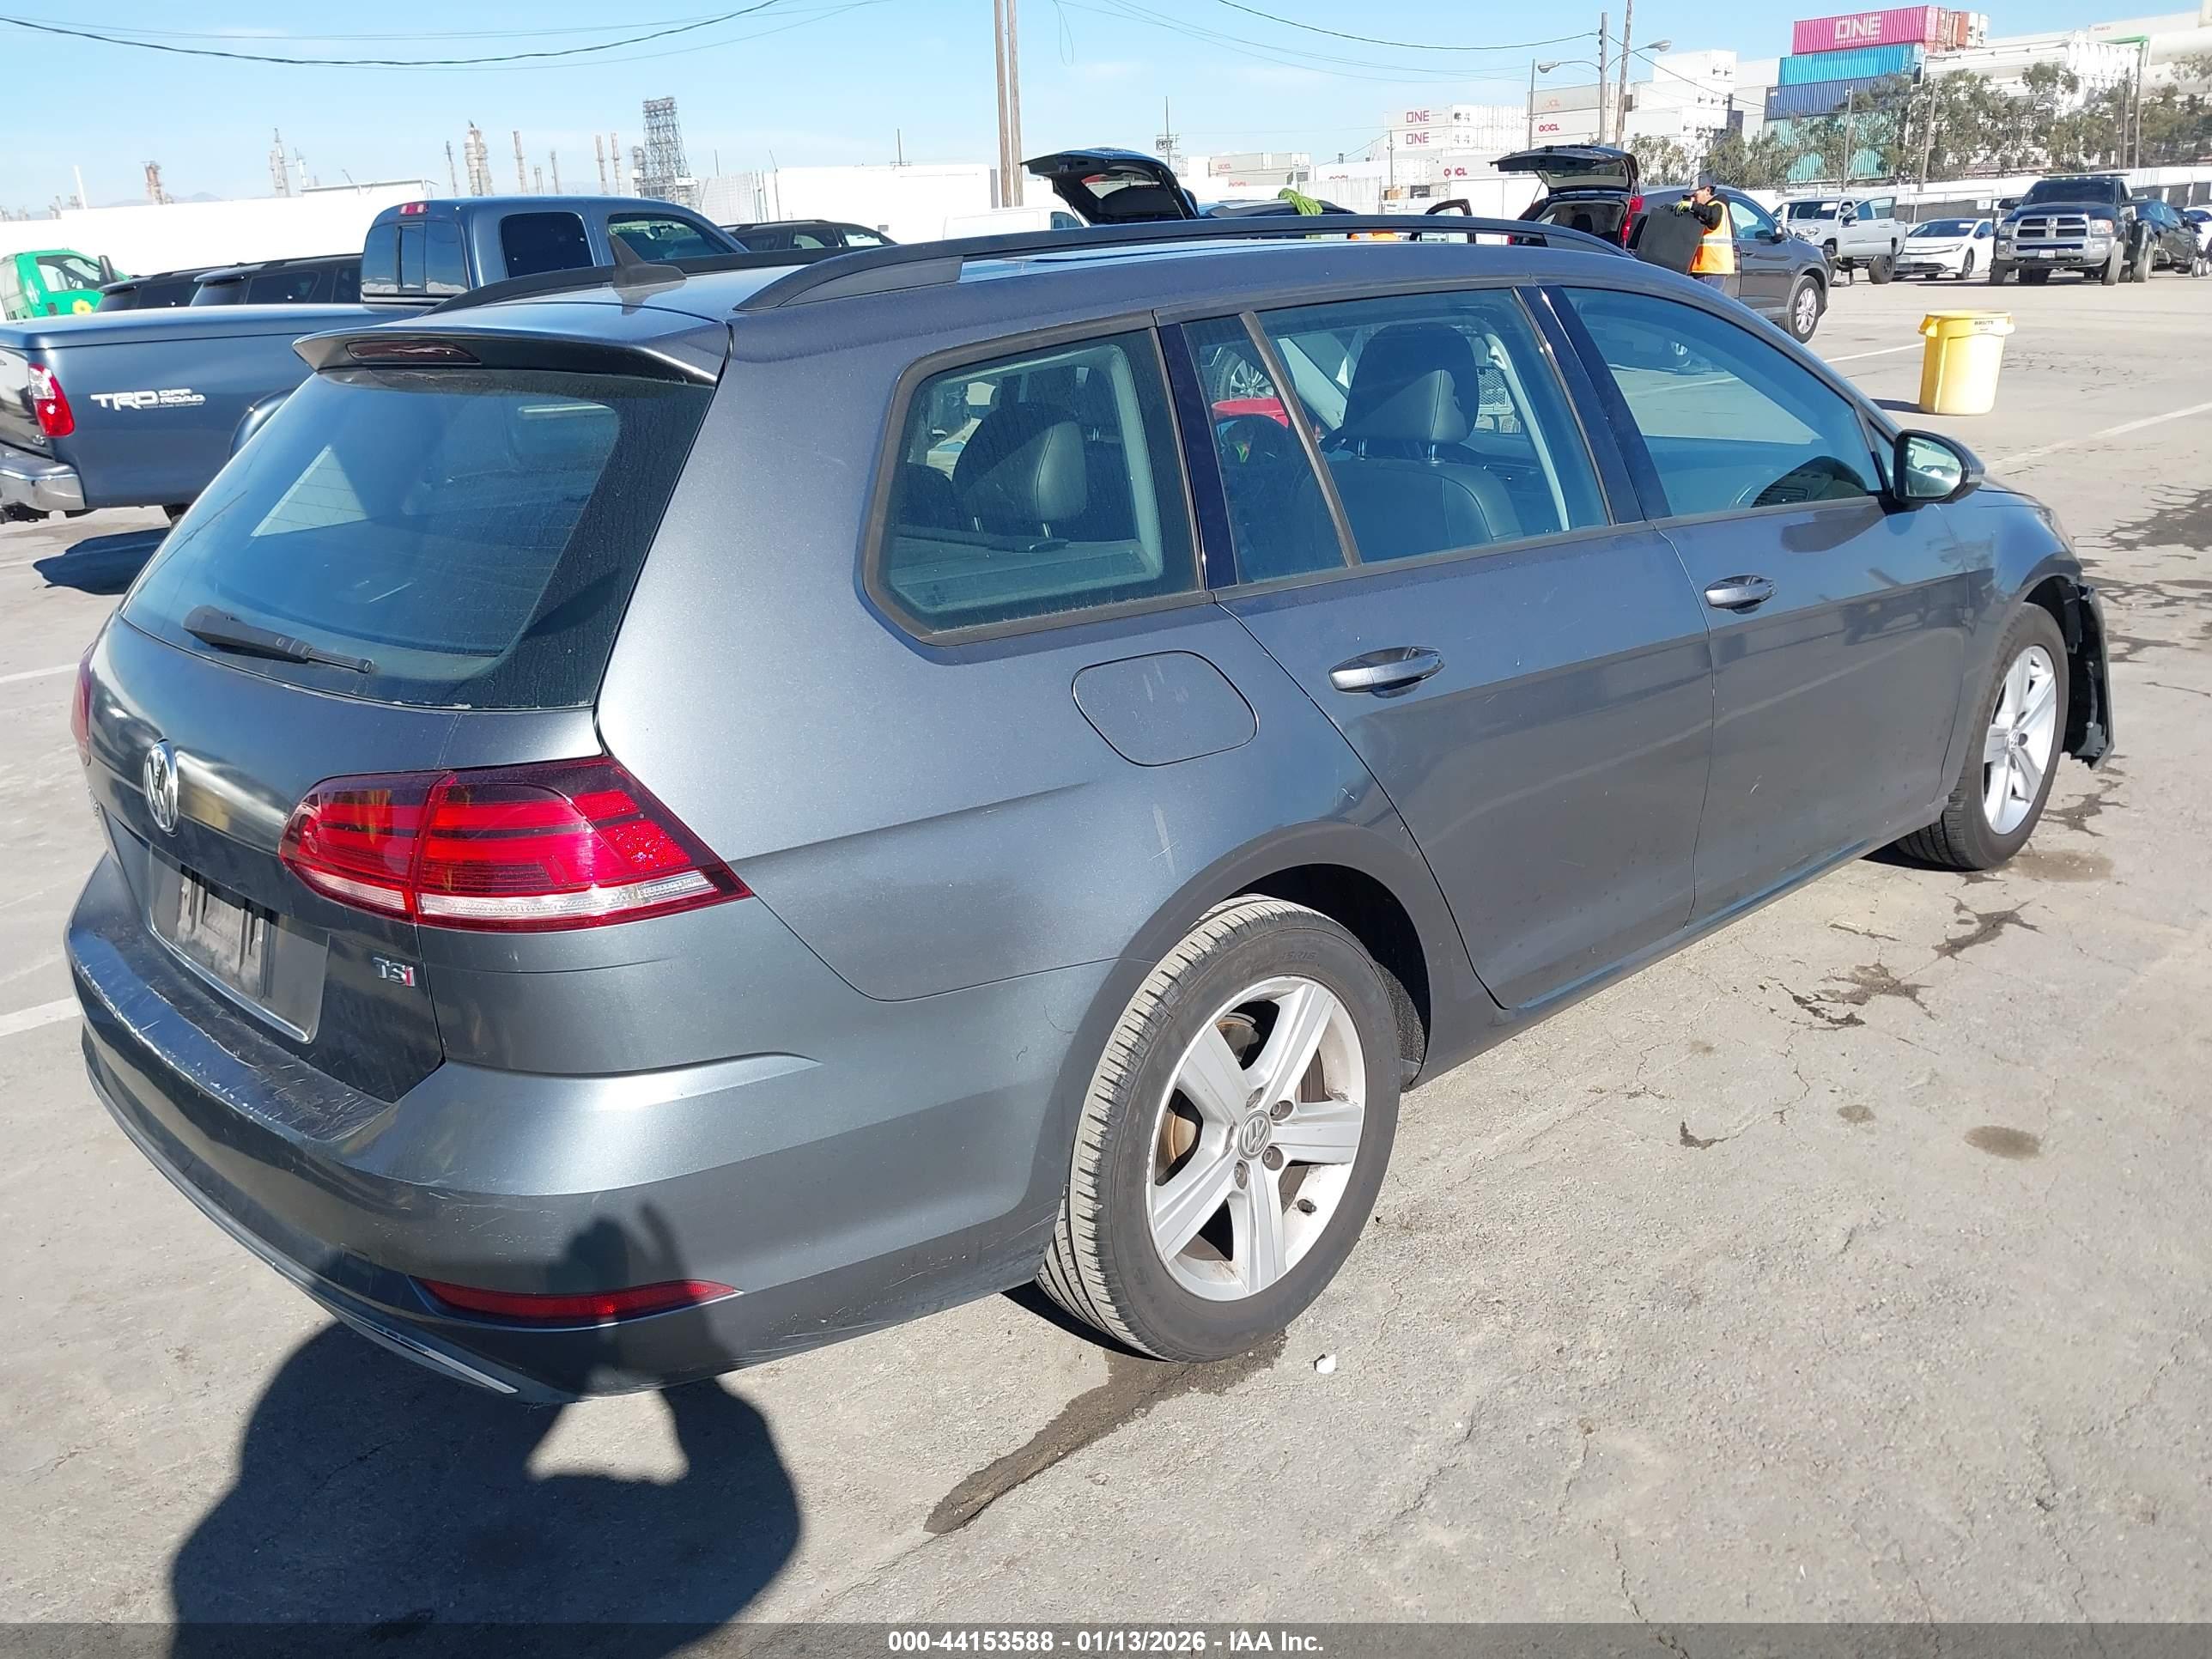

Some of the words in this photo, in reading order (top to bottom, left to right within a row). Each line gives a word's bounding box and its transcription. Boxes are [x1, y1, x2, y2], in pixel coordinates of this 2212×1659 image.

[1835, 15, 1881, 40] ONE
[1407, 110, 1430, 123] ONE
[1406, 131, 1430, 144] ONE
[89, 391, 159, 412] TRD
[159, 394, 207, 404] ROAD
